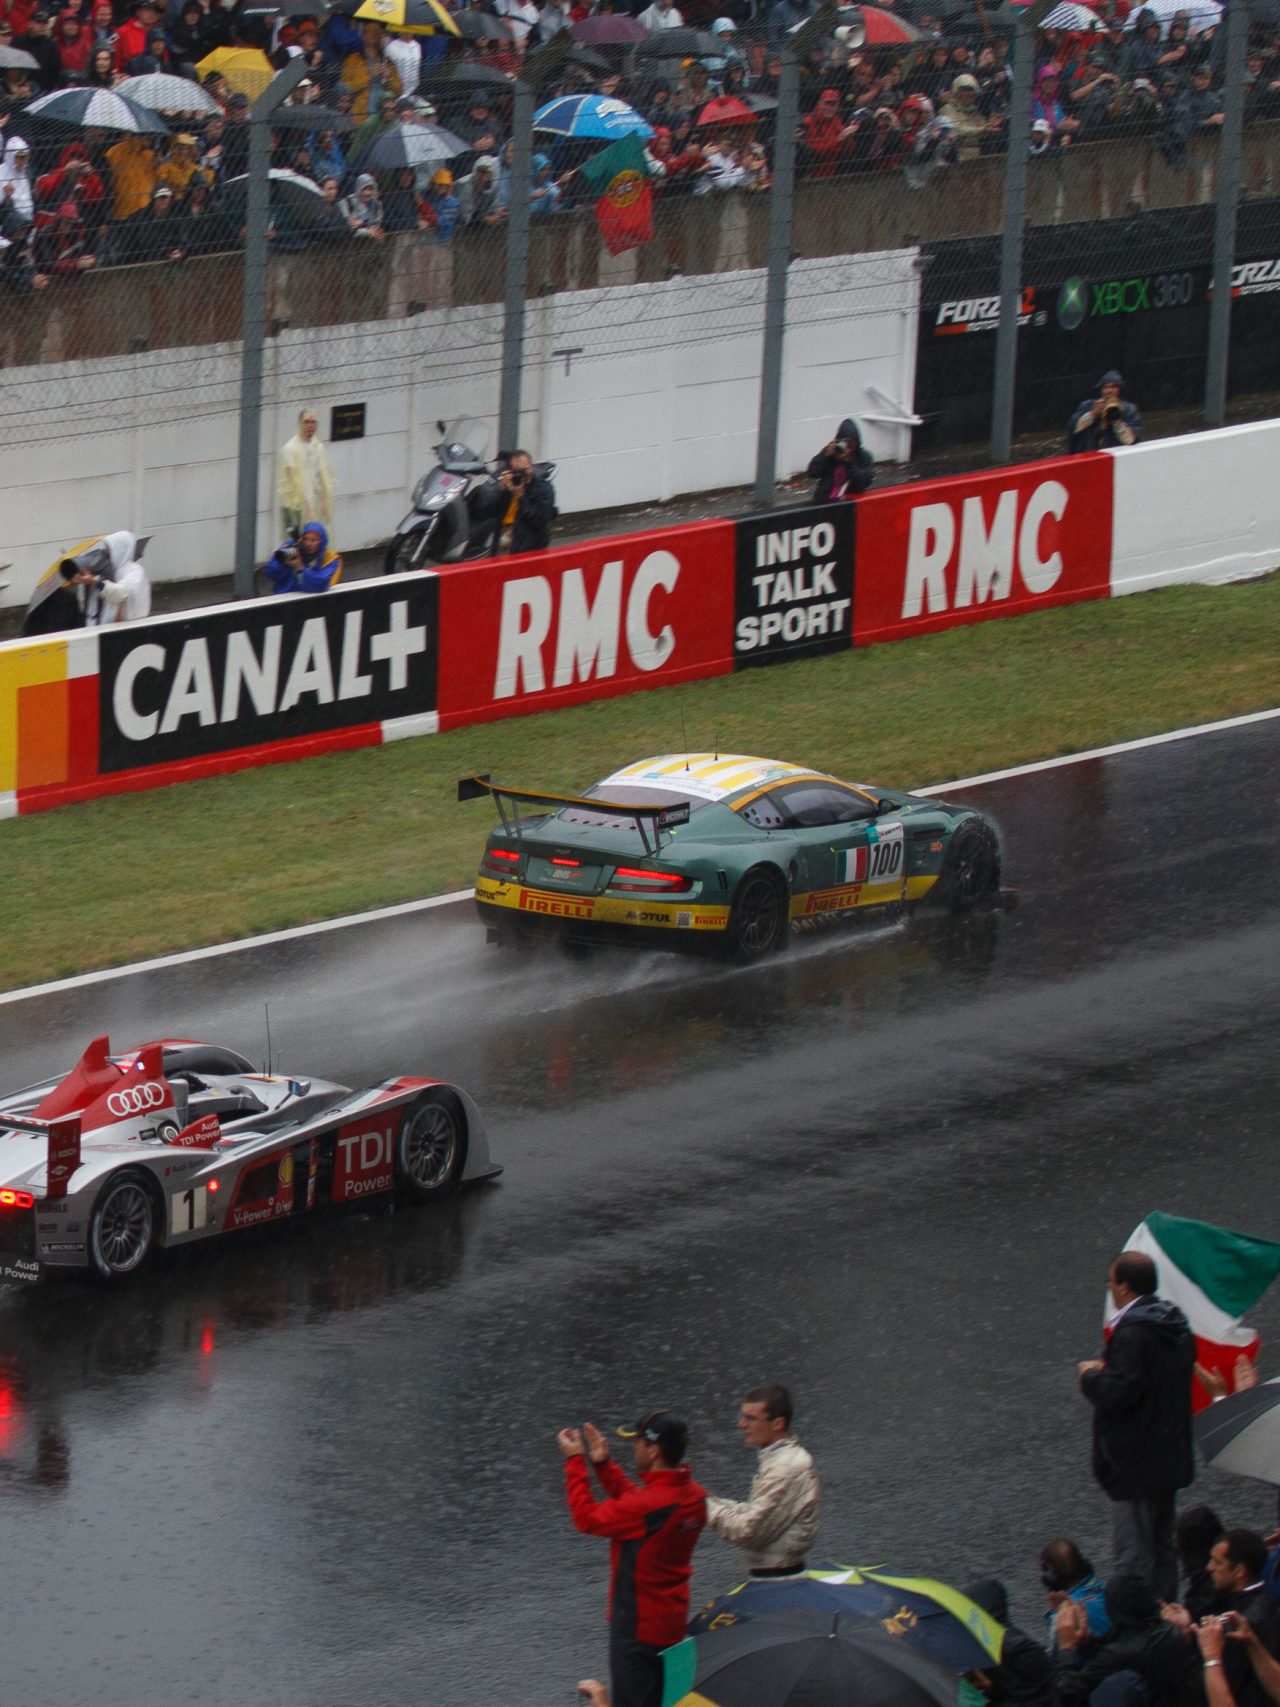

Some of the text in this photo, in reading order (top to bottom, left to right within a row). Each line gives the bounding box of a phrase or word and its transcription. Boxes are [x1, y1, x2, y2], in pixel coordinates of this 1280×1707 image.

[1208, 259, 1280, 289] ORZ
[1090, 273, 1193, 317] XBOX 360
[756, 521, 835, 568] INFO
[901, 480, 1069, 619] RMC
[752, 563, 836, 608] TALK
[493, 549, 681, 700] RMC
[735, 598, 851, 651] SPORT
[112, 599, 426, 742] CANAL+
[871, 841, 902, 877] 100
[519, 889, 596, 919] PIRELLI
[804, 884, 862, 914] PIRELLI
[625, 909, 671, 923] MOTUL
[180, 1129, 220, 1147] TDI Power
[201, 1120, 219, 1131] Audi
[337, 1128, 393, 1174] TDI
[344, 1174, 392, 1196] Power
[183, 1188, 195, 1230] 1
[233, 1207, 272, 1225] V-Power
[4, 1265, 39, 1281] Power
[15, 1258, 39, 1272] Audi
